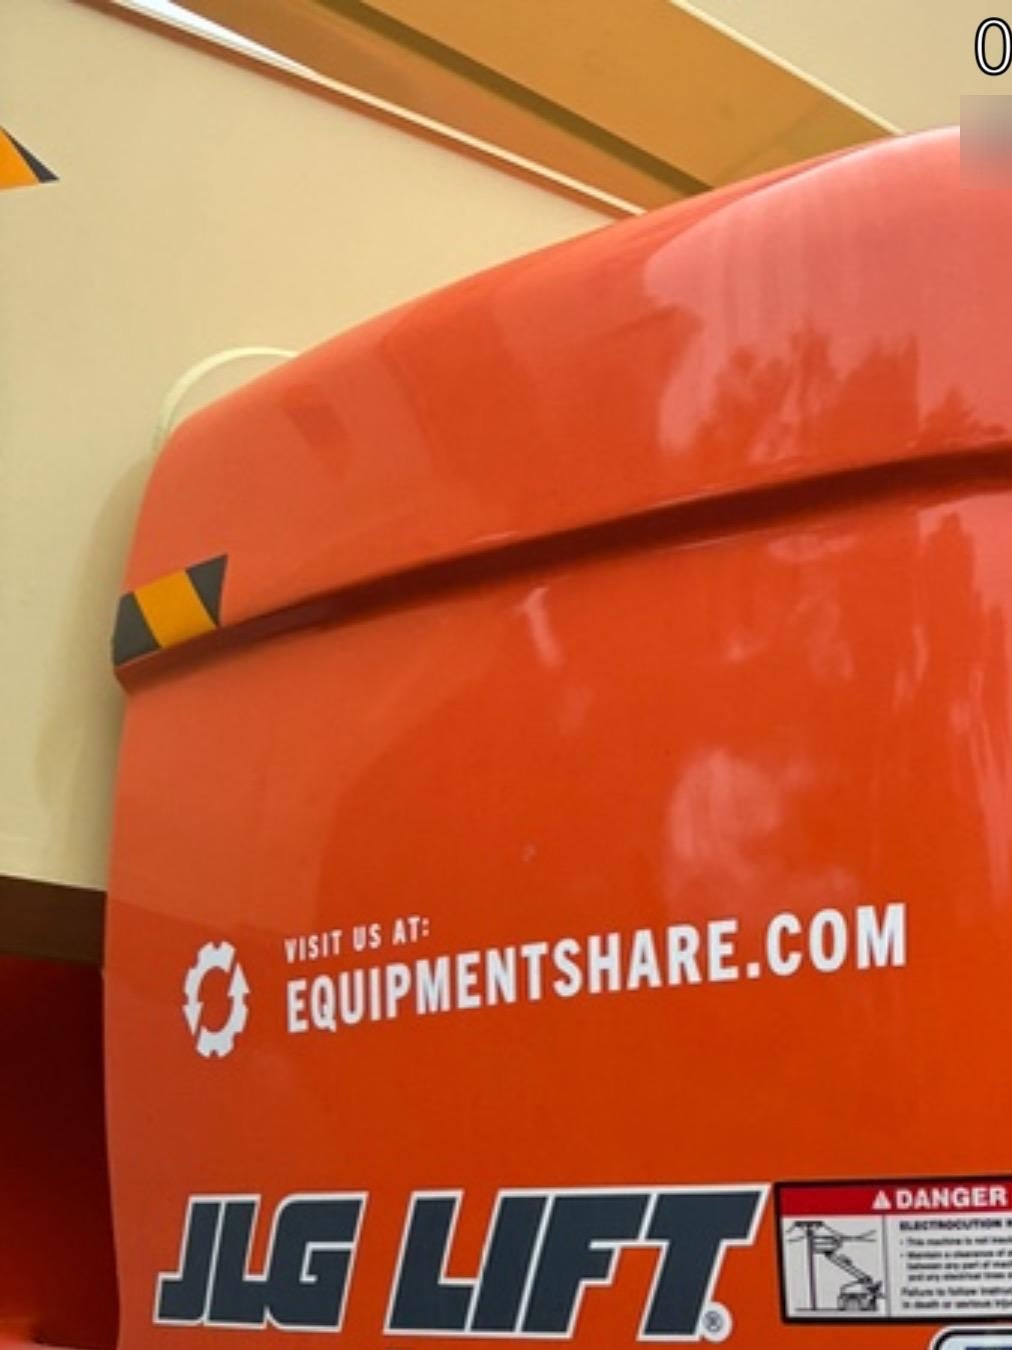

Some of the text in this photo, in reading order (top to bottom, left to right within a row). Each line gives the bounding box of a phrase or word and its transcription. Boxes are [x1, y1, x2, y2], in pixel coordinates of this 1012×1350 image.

[285, 915, 430, 964] VISIT US AT:
[286, 903, 907, 1034] EQUIPMENTSHARE.COM
[896, 1187, 1007, 1209] DANGER
[899, 1219, 1002, 1231] ELECTROCUTION
[153, 1191, 369, 1332] JLG
